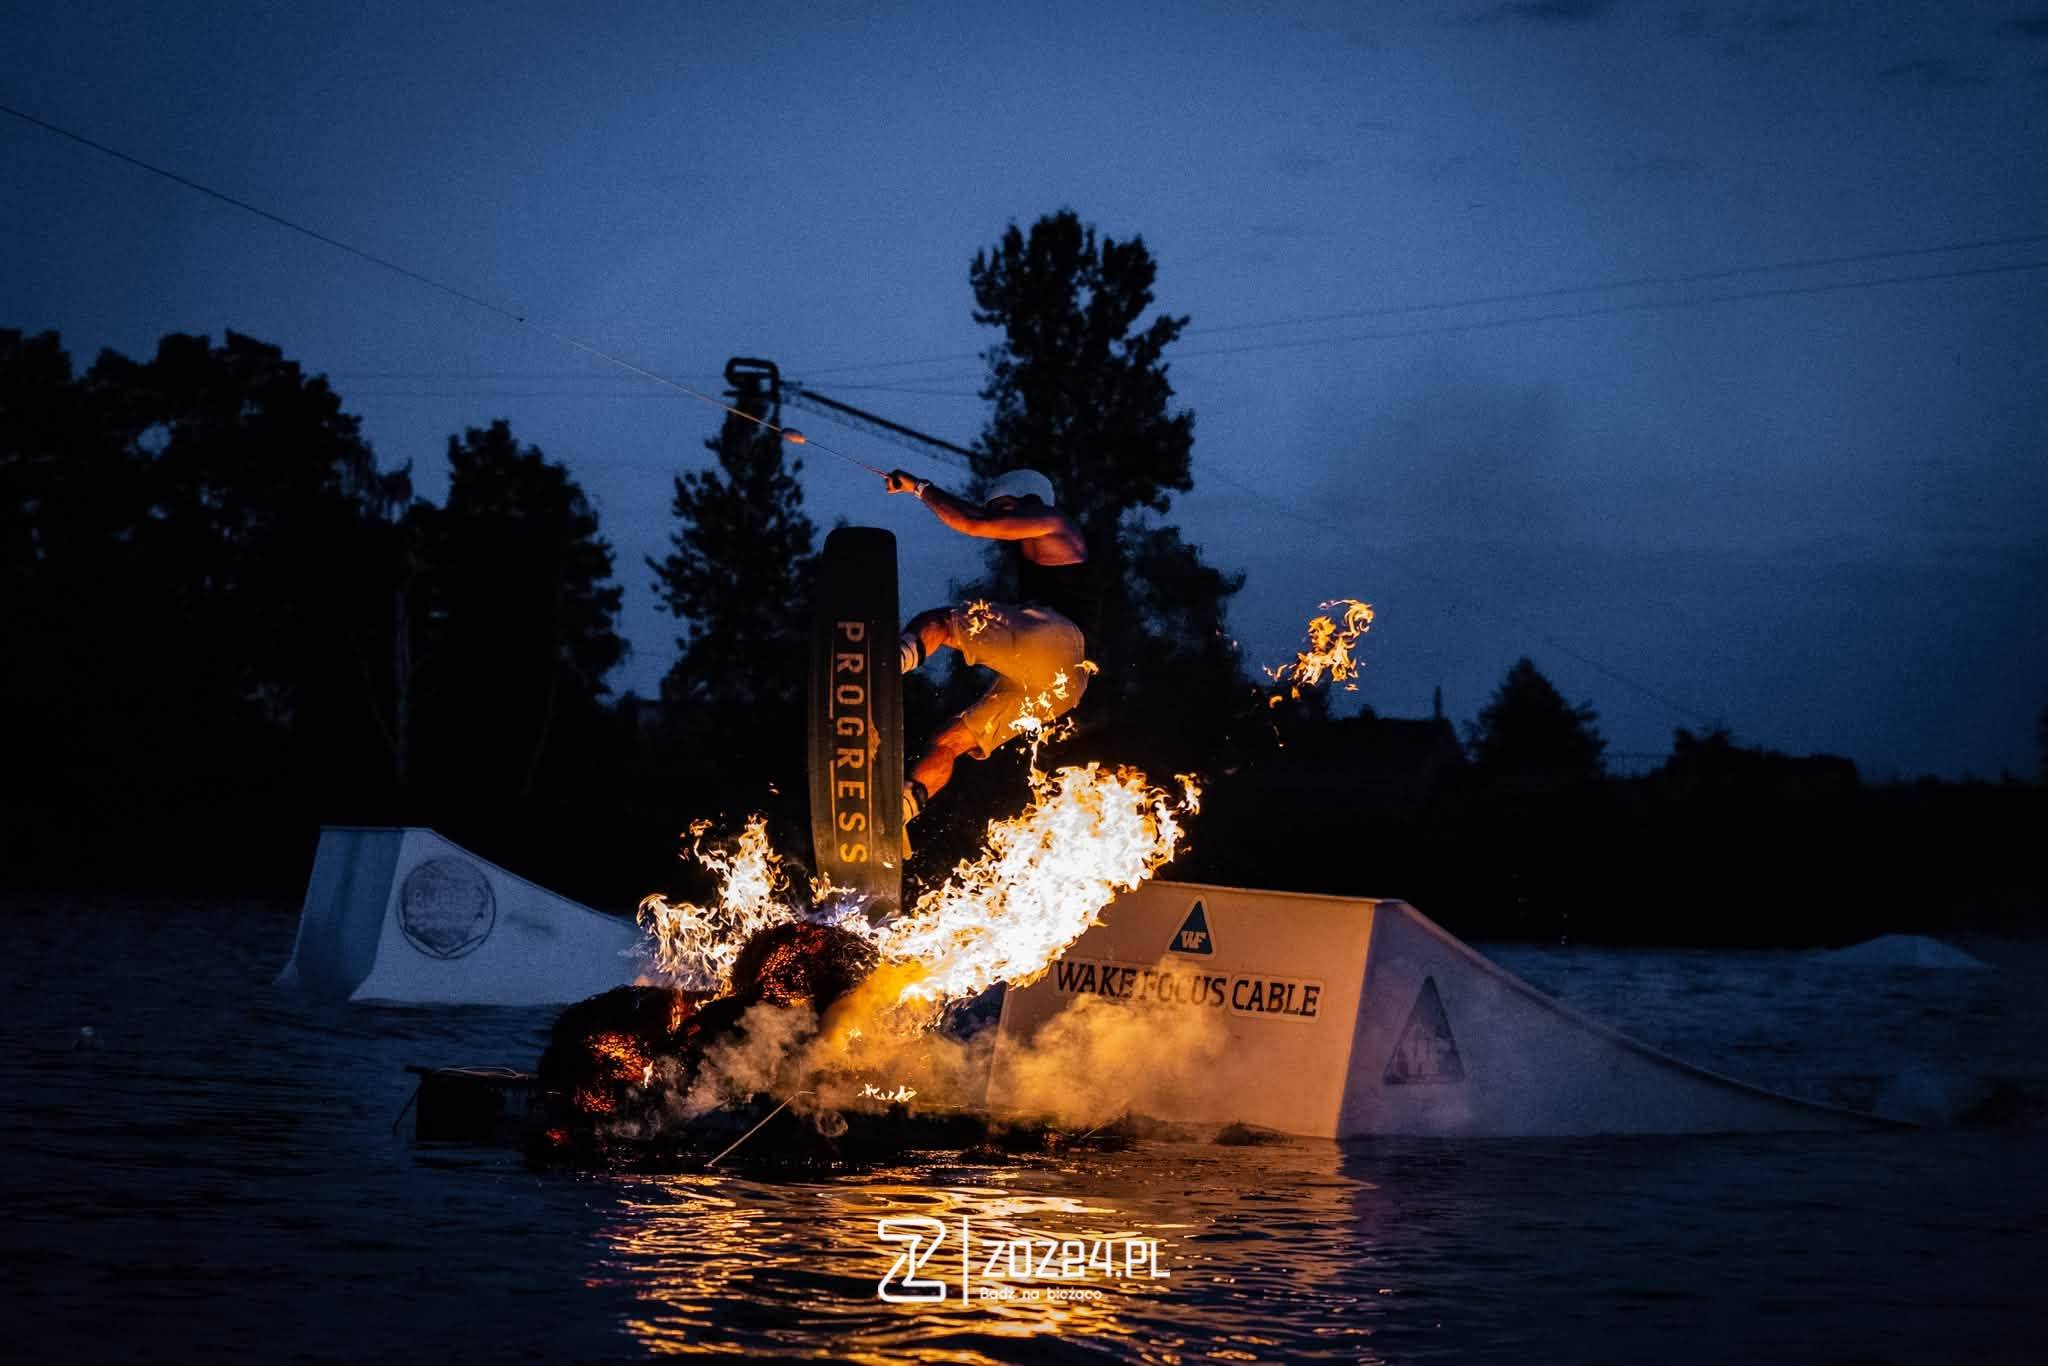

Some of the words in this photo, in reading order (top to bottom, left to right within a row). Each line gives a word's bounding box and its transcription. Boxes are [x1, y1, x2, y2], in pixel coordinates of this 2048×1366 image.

[836, 620, 868, 864] PROGRESS
[1180, 930, 1207, 950] WF
[1055, 960, 1137, 999] WAKE
[1140, 970, 1227, 1008] FOCUS
[1231, 979, 1321, 1017] CABLE
